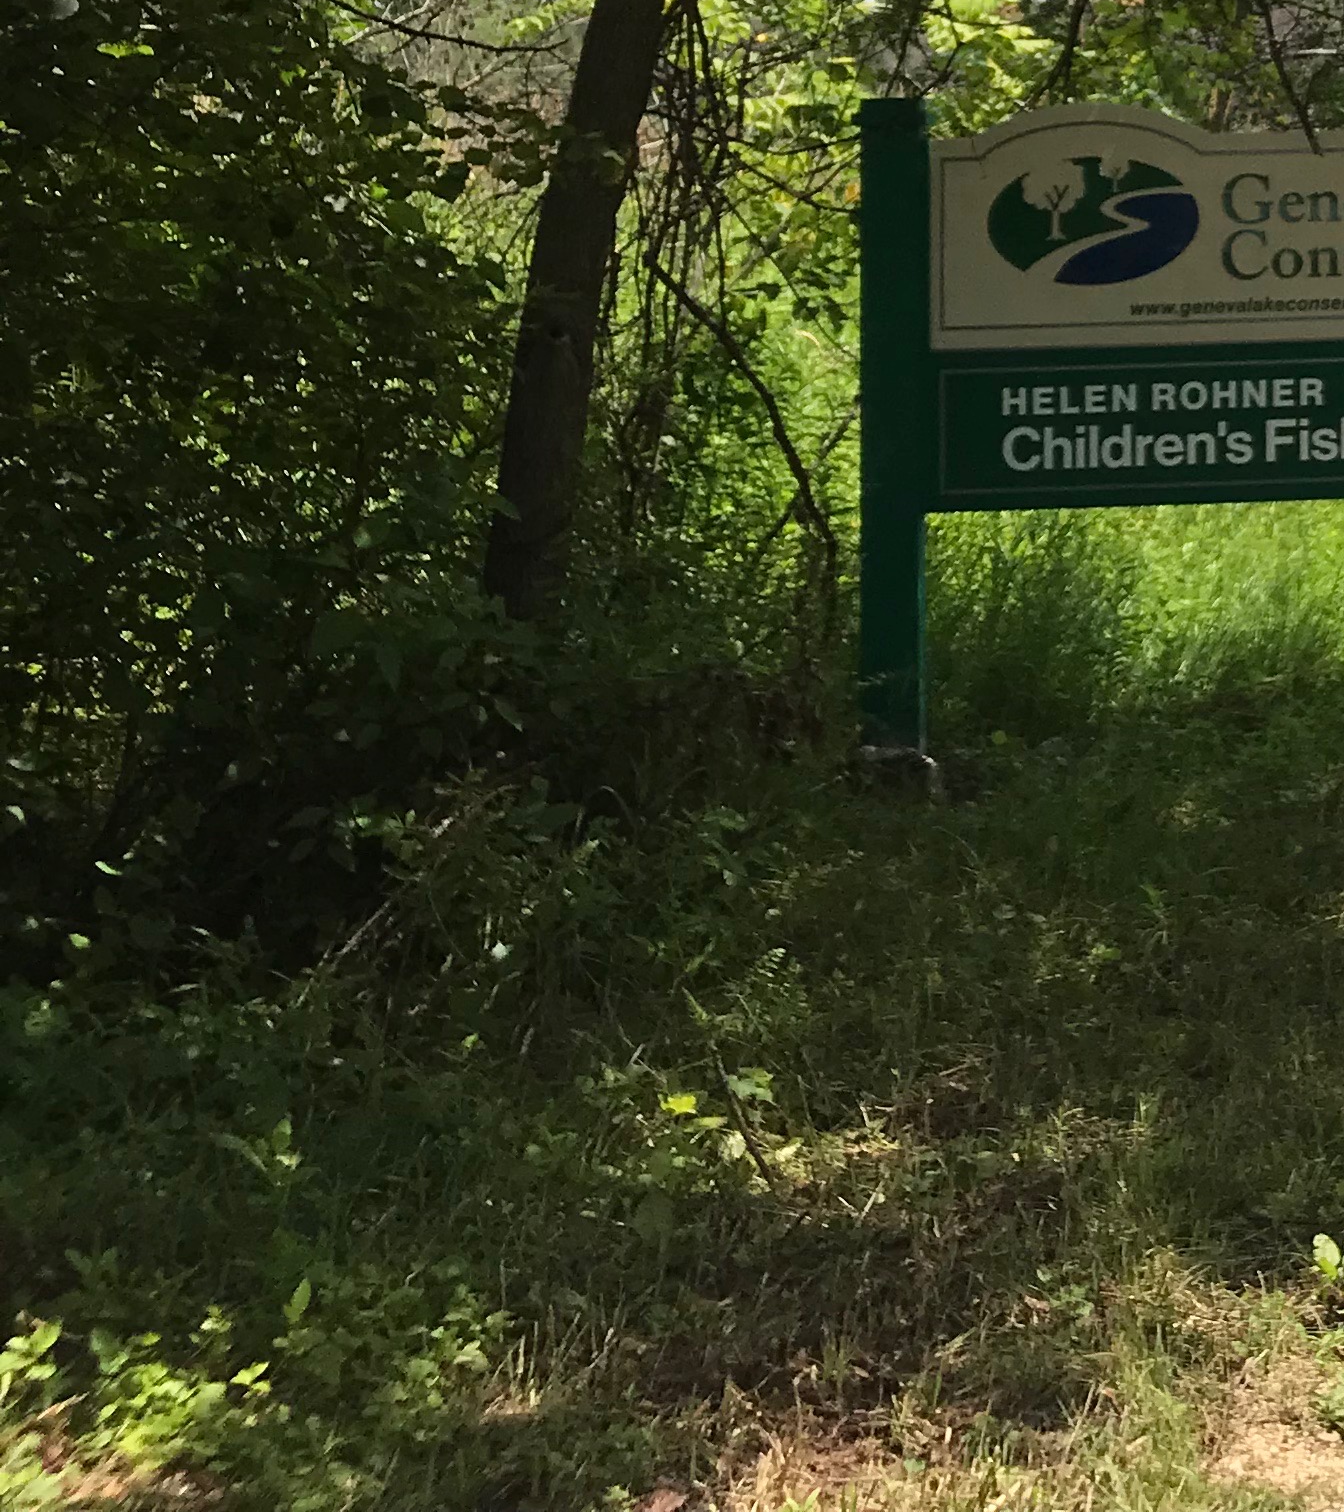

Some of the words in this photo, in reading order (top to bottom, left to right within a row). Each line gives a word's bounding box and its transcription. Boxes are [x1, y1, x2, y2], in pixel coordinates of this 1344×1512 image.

[1001, 384, 1137, 417] HELEN
[1151, 377, 1326, 413] ROHNER
[1001, 420, 1253, 472] Children's
